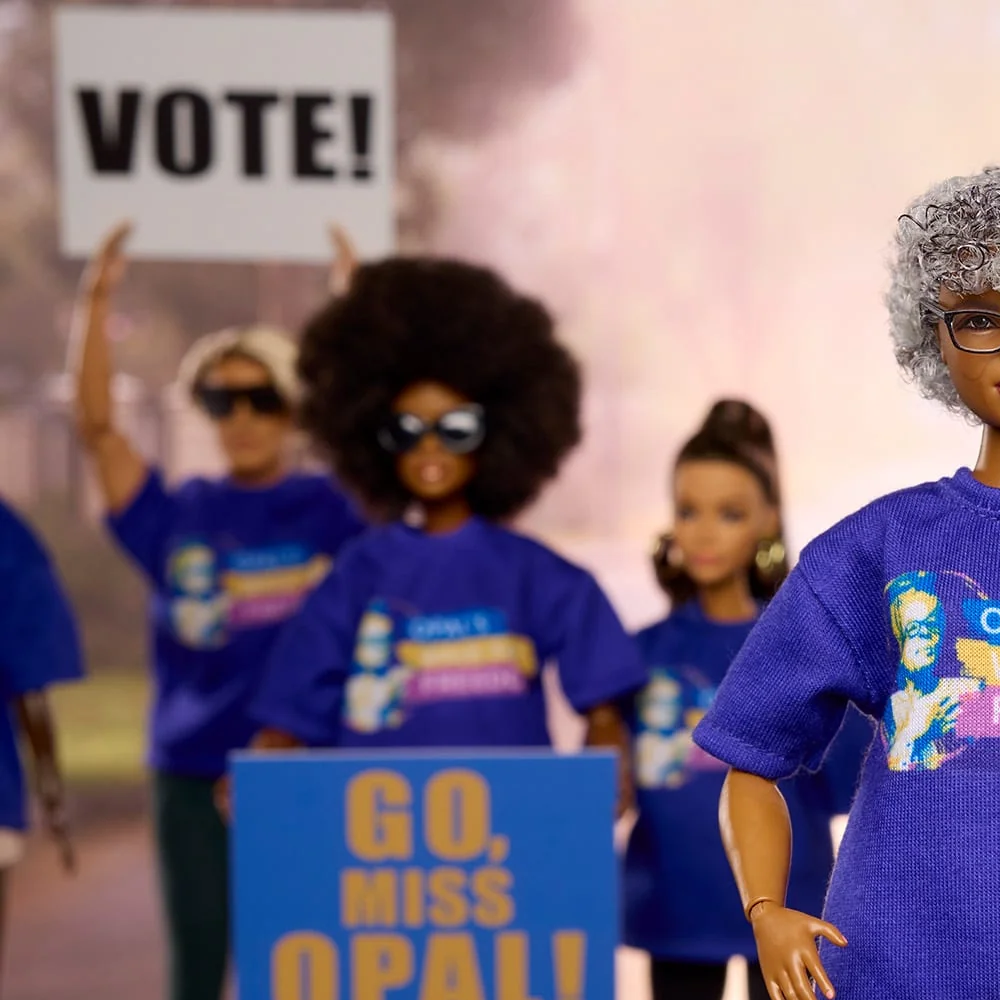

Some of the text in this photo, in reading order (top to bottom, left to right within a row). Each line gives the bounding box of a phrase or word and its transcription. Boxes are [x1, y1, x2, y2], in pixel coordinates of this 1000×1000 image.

[75, 86, 375, 180] VOTE!
[345, 768, 509, 864] GO,
[341, 866, 515, 929] MISS
